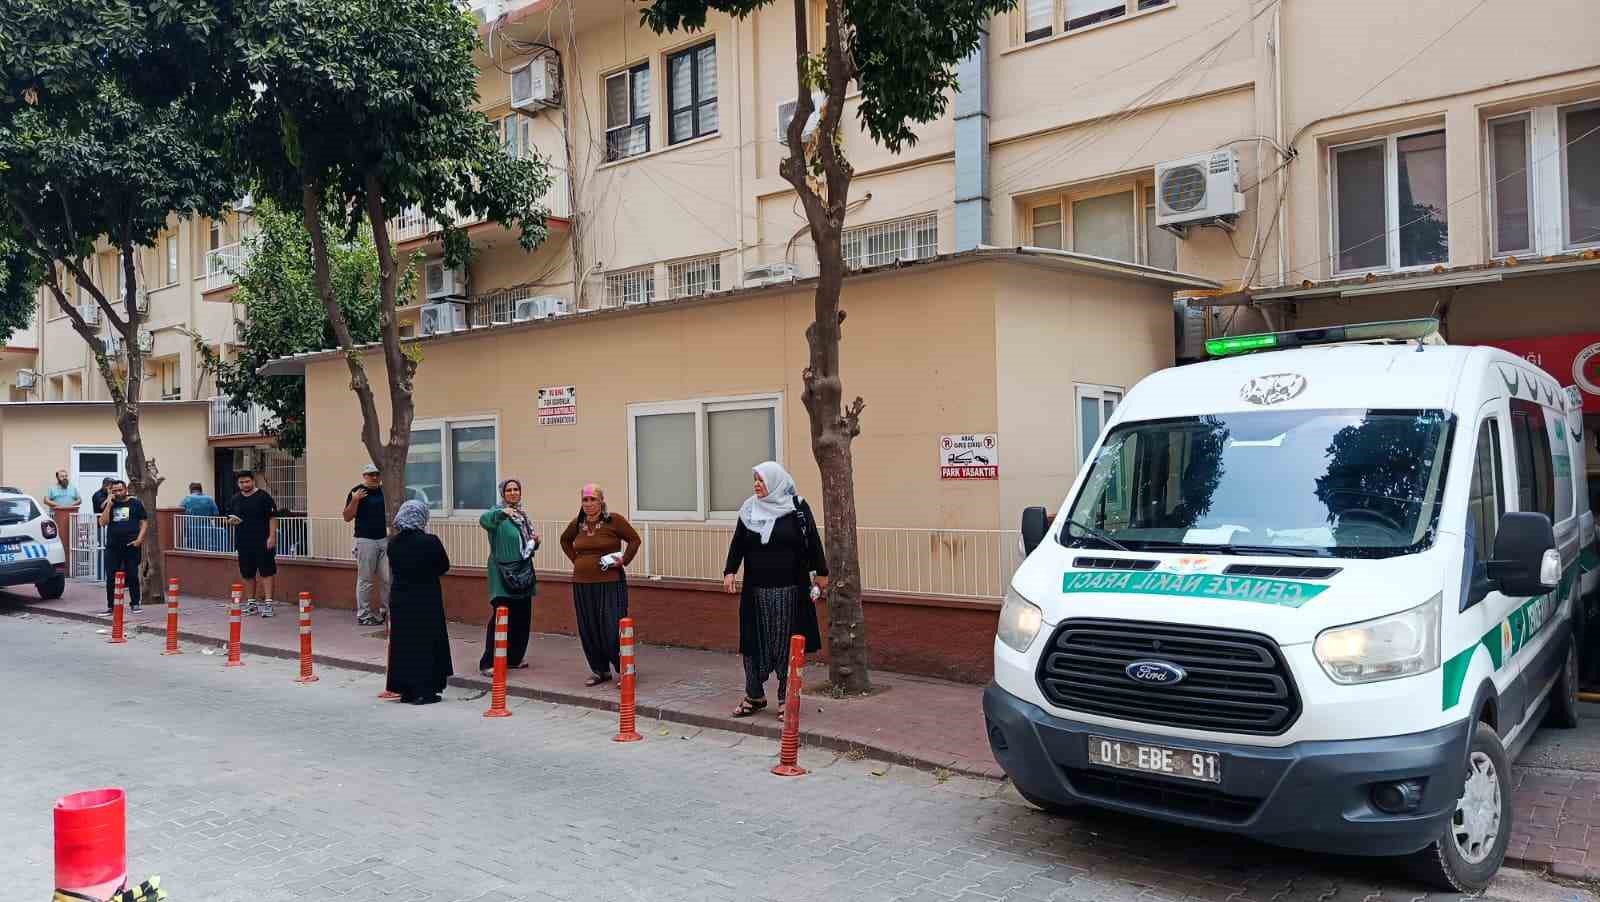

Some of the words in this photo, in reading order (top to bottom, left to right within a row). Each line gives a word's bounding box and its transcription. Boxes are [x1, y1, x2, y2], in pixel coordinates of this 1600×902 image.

[943, 467, 960, 478] PARK
[961, 467, 995, 478] YASAKTIR
[1136, 665, 1168, 681] Ford
[1101, 740, 1121, 764] 01
[1138, 746, 1174, 772] EBE
[1191, 753, 1215, 778] 91
